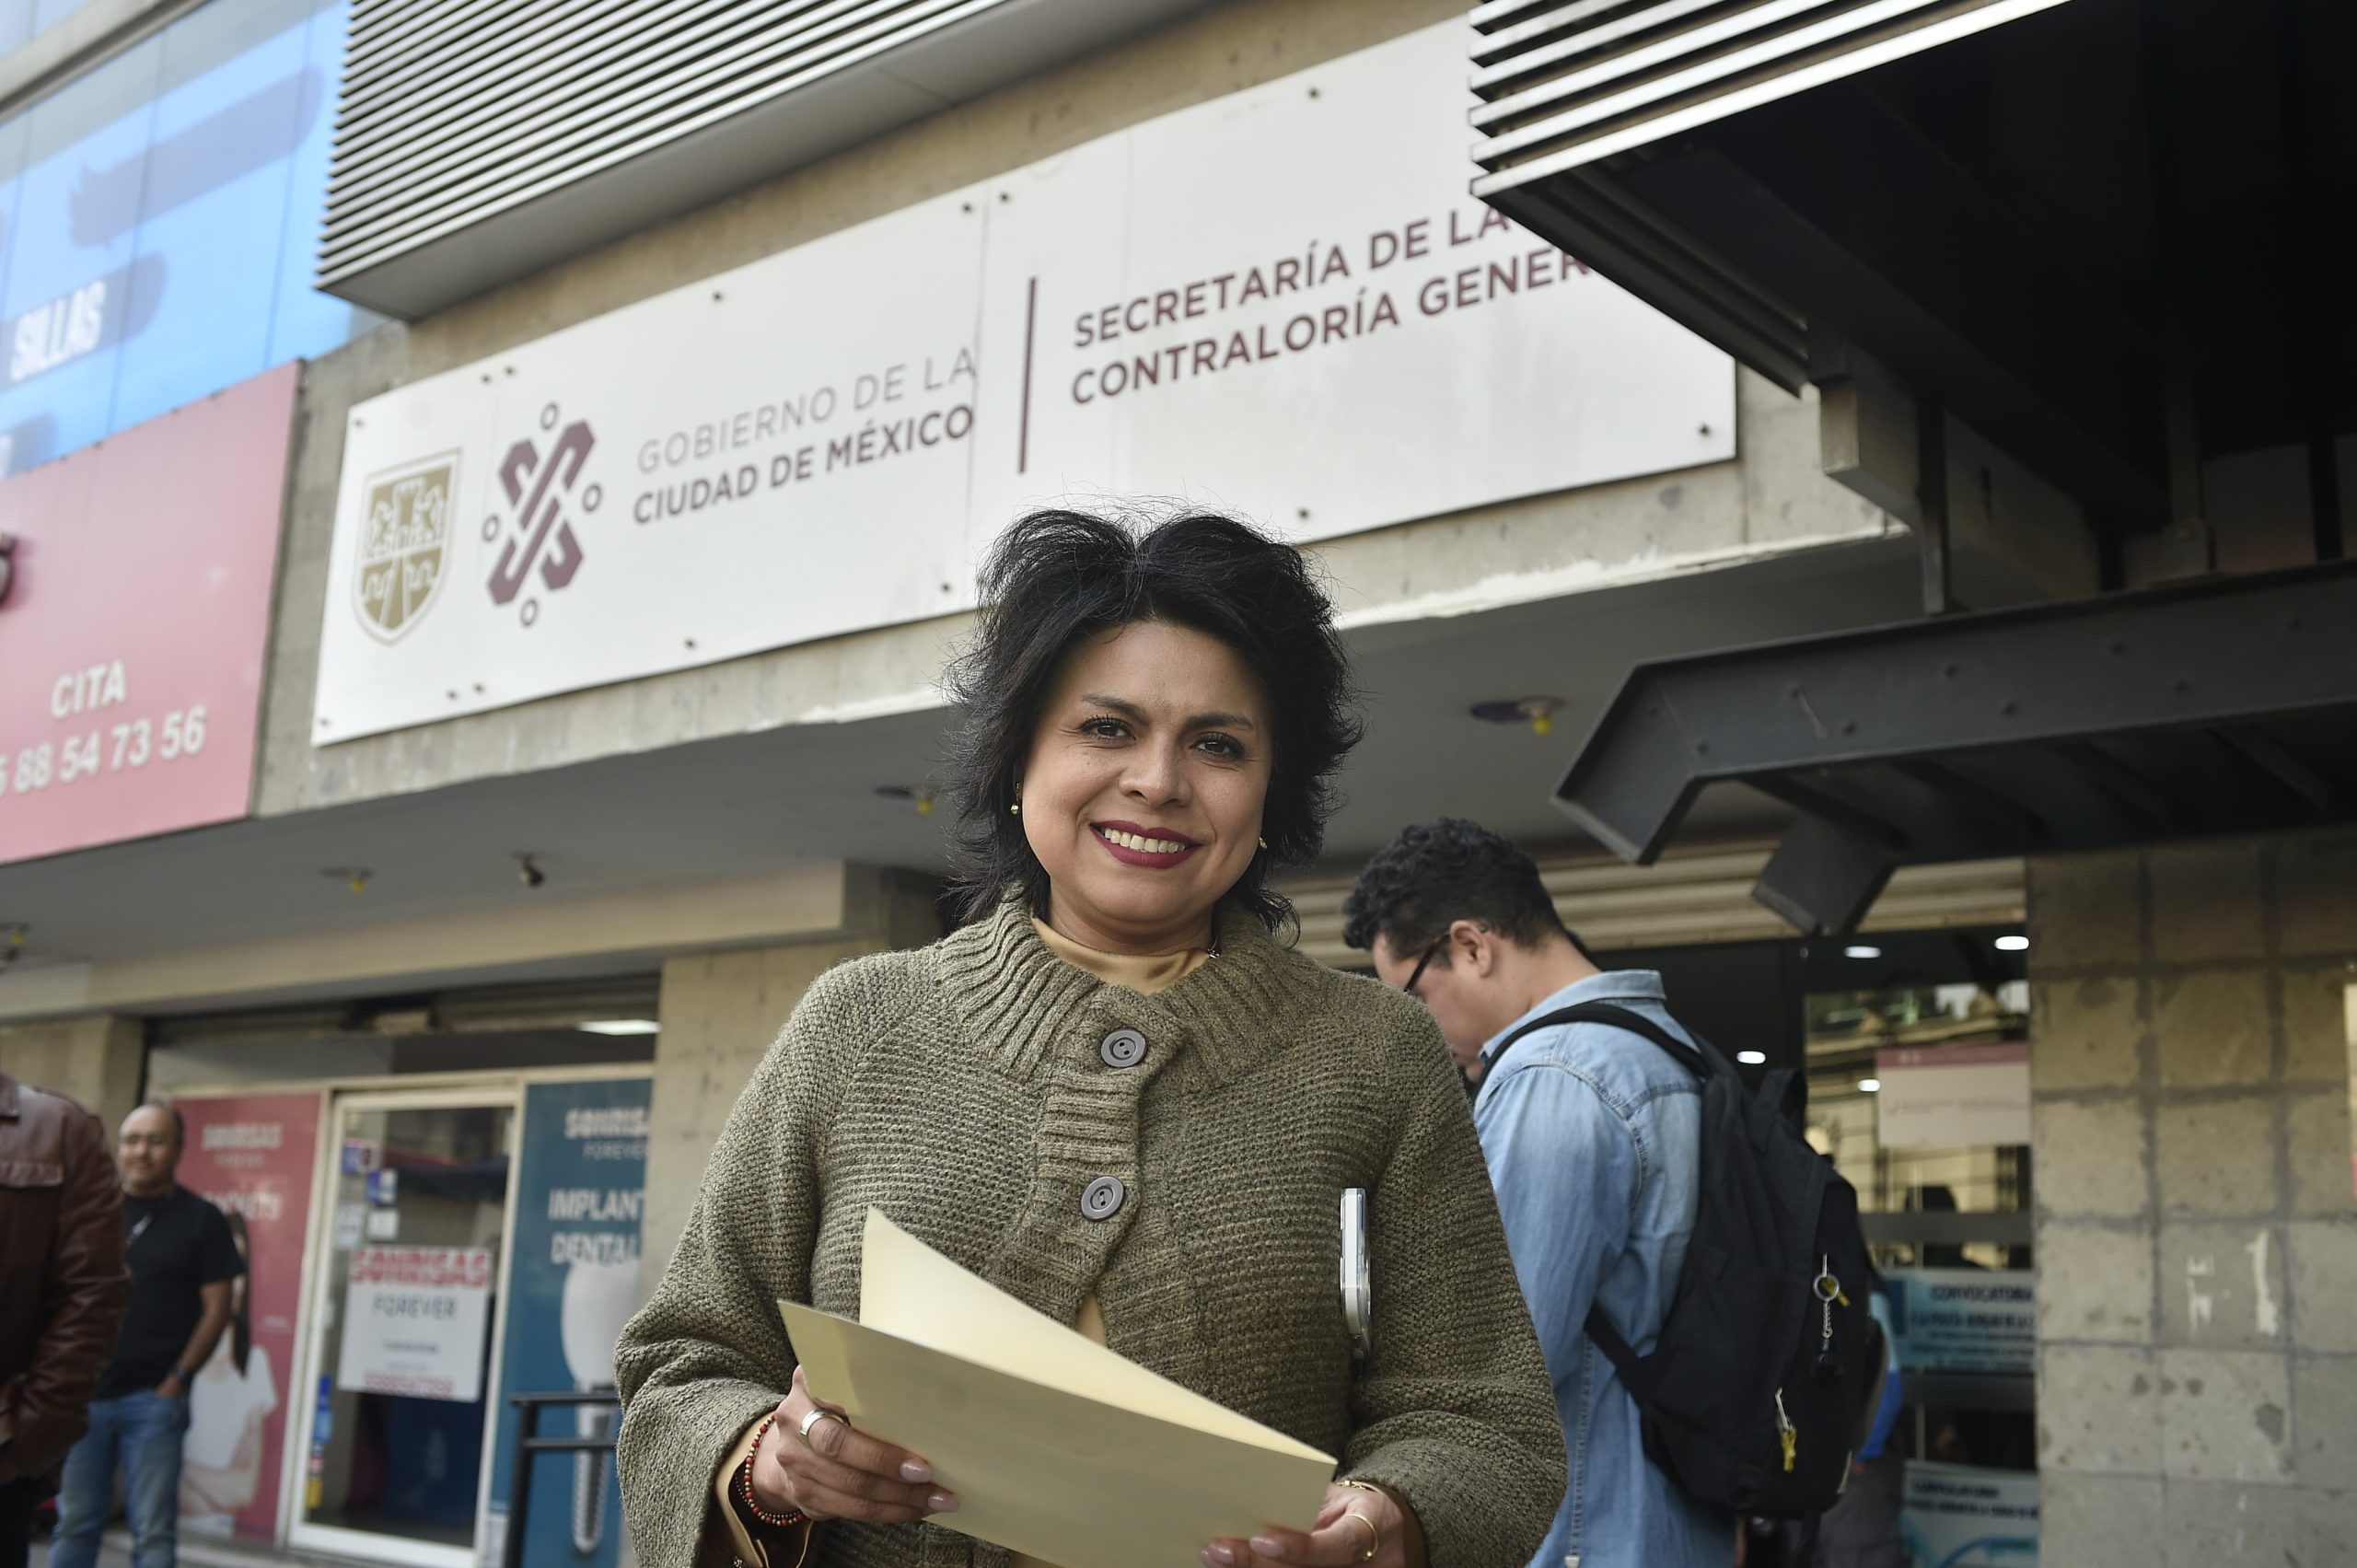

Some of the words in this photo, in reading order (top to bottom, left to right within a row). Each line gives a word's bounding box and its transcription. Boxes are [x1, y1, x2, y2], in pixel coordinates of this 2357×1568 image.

[1074, 239, 1349, 349] SECRETARÍA
[1369, 217, 1430, 270] DE
[1448, 205, 1509, 247] LA
[1072, 288, 1399, 405] CONTRALORÍA
[633, 464, 759, 525] CIUDAD
[770, 446, 815, 490] DE
[826, 403, 975, 472] MÉXICO
[637, 386, 838, 475] GOBIERNO
[853, 364, 907, 412] DE
[924, 345, 977, 392] LA
[52, 658, 126, 720] CITA
[14, 741, 53, 795] 88
[59, 729, 100, 783] 54
[110, 717, 151, 771] 73
[159, 703, 207, 760] 56
